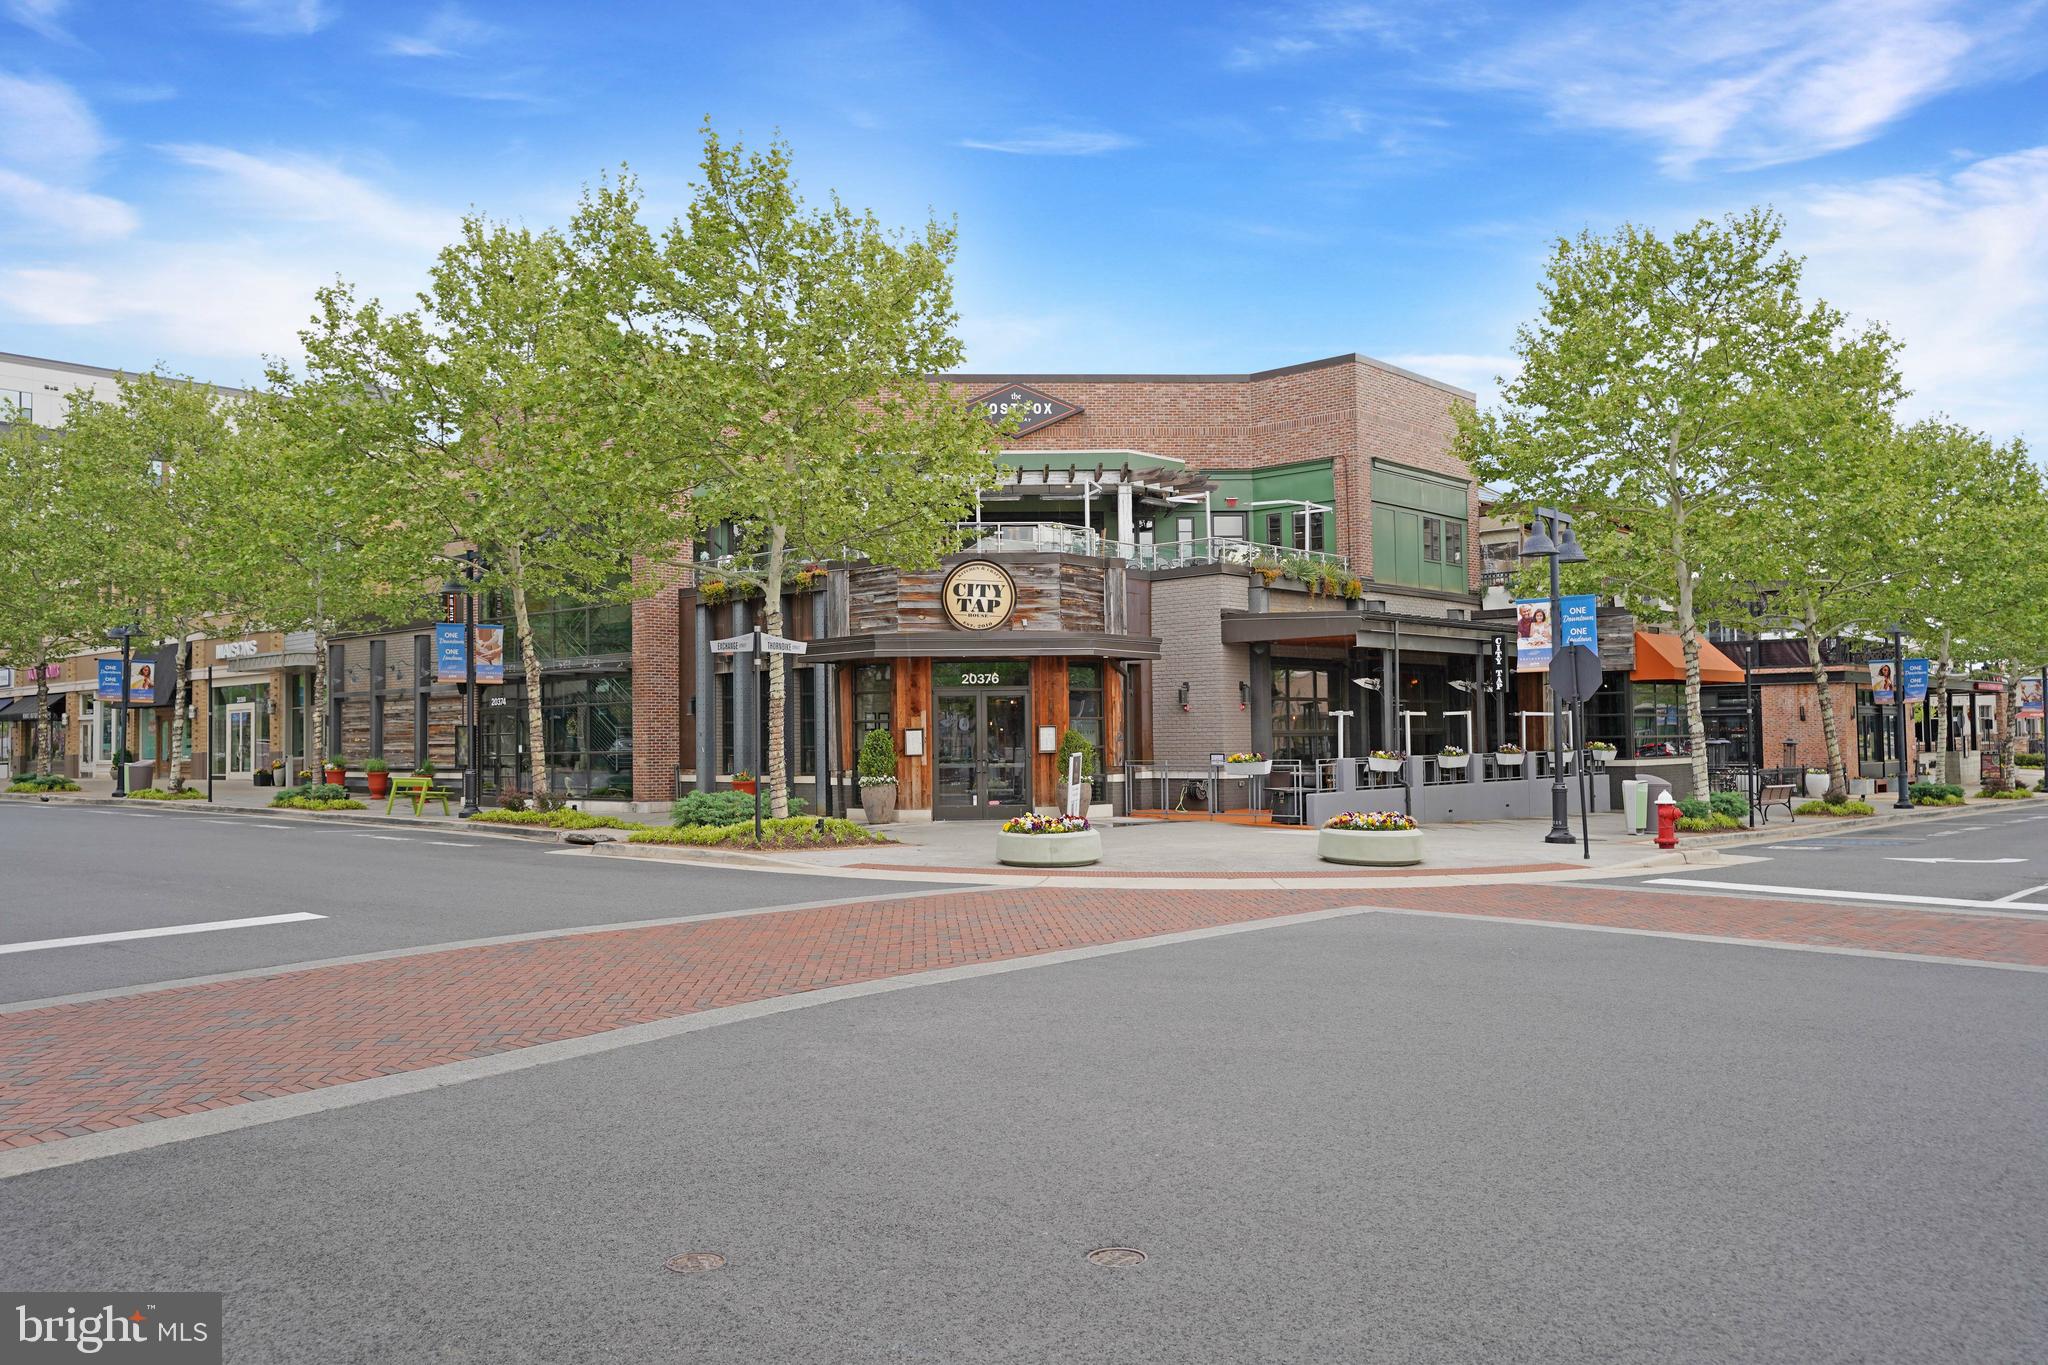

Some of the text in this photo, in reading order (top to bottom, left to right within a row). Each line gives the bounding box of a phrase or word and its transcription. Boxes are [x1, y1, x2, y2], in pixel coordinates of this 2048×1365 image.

[1011, 392, 1022, 400] the
[953, 582, 1005, 598] CITY
[956, 598, 1001, 613] TAP
[1569, 607, 1587, 615] ONE
[1562, 614, 1594, 623] Downtown
[1570, 627, 1588, 636] ONE
[1566, 635, 1593, 644] Loudoun
[1494, 637, 1503, 690] CITY TAP
[961, 673, 1000, 684] 20376
[491, 697, 506, 706] 20374
